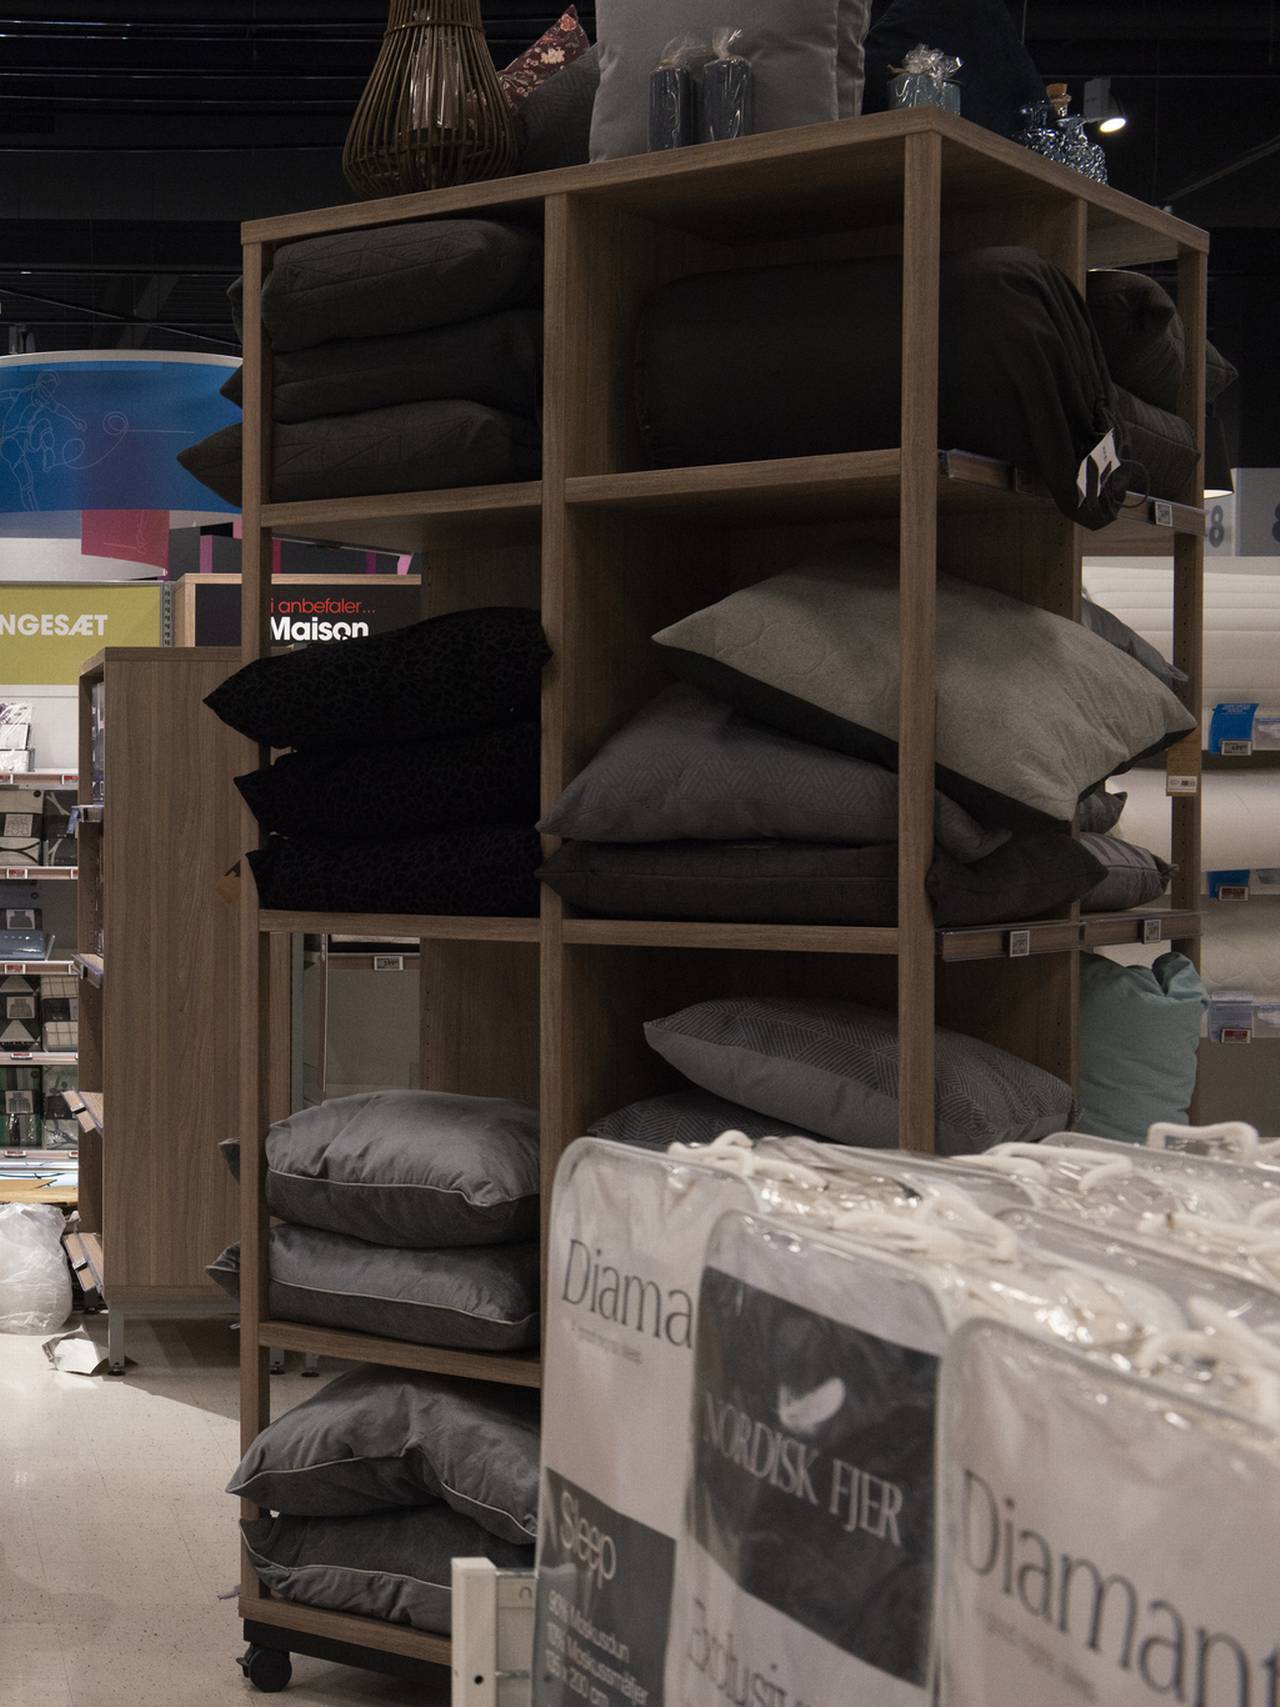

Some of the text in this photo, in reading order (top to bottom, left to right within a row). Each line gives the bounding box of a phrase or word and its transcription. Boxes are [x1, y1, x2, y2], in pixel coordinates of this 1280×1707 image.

[271, 617, 369, 641] Maison
[563, 1239, 692, 1349] Diama
[703, 1389, 903, 1546] NORDISK FJER
[560, 1491, 616, 1589] Sleep
